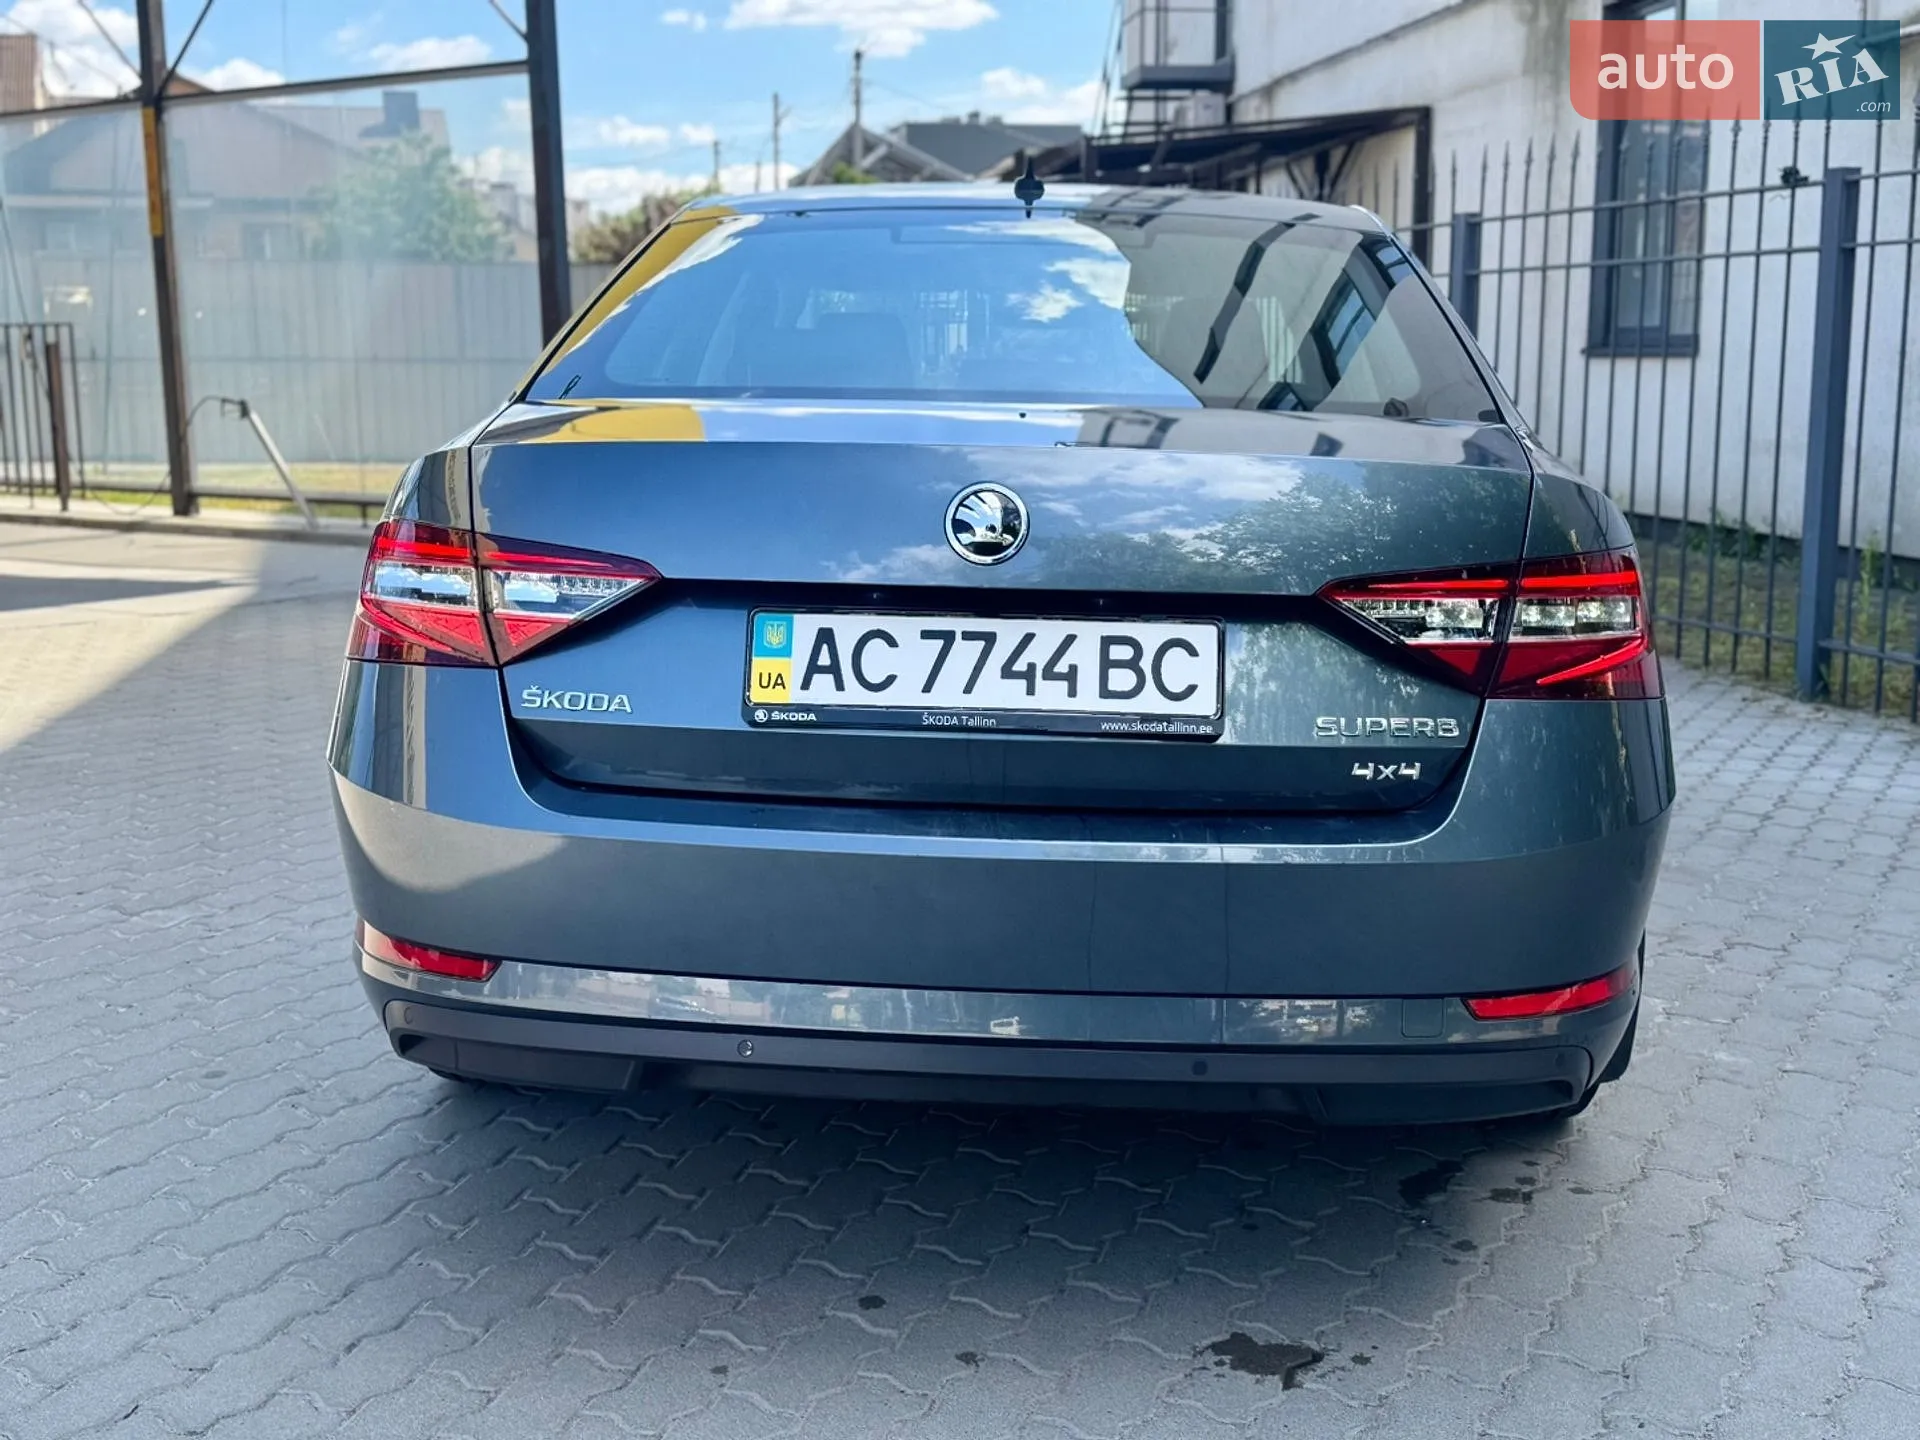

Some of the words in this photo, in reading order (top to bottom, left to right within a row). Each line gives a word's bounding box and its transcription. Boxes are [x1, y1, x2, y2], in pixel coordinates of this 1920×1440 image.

[799, 627, 900, 693] AC
[919, 629, 1078, 699] 7744
[1099, 634, 1200, 702] BC
[758, 671, 787, 691] UA
[520, 684, 633, 713] ŠKODA
[771, 710, 818, 721] ŠKODA
[922, 712, 959, 726] ŠKODA
[961, 715, 997, 727] Tallinn
[1100, 720, 1213, 734] www.skodatallinn.ee
[1315, 716, 1461, 738] SUPERB
[1351, 762, 1422, 781] 4x4
